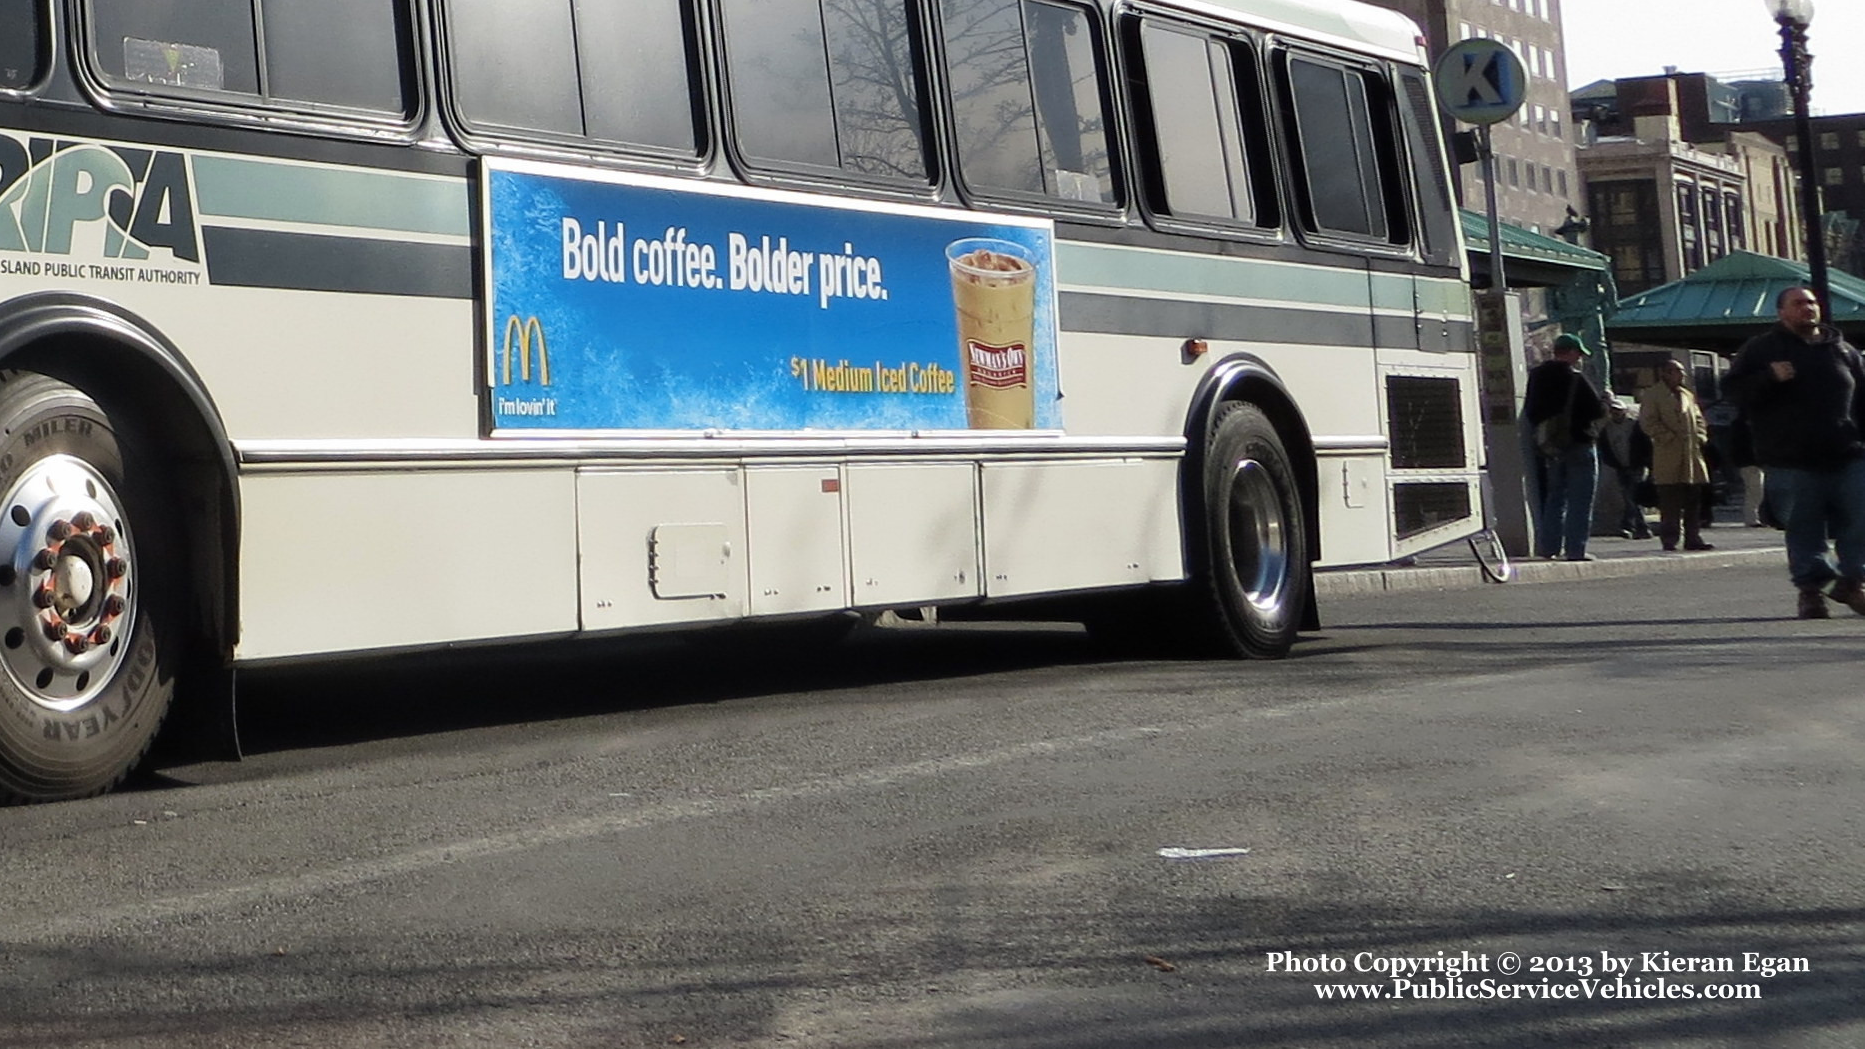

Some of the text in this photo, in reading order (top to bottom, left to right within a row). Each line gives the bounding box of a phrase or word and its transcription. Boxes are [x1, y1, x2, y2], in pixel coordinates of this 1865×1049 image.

[1454, 52, 1506, 107] K
[44, 263, 86, 278] PUBLIC
[88, 265, 135, 282] TRANSIT
[137, 268, 201, 285] AUTHORITY
[562, 217, 888, 309] Bold coffee. Bolder price.
[791, 356, 955, 393] $1 Medium Iced Coffee
[516, 397, 545, 416] lovin'
[546, 398, 556, 416] it
[23, 416, 93, 449] MILER
[43, 613, 156, 742] ODYEAR
